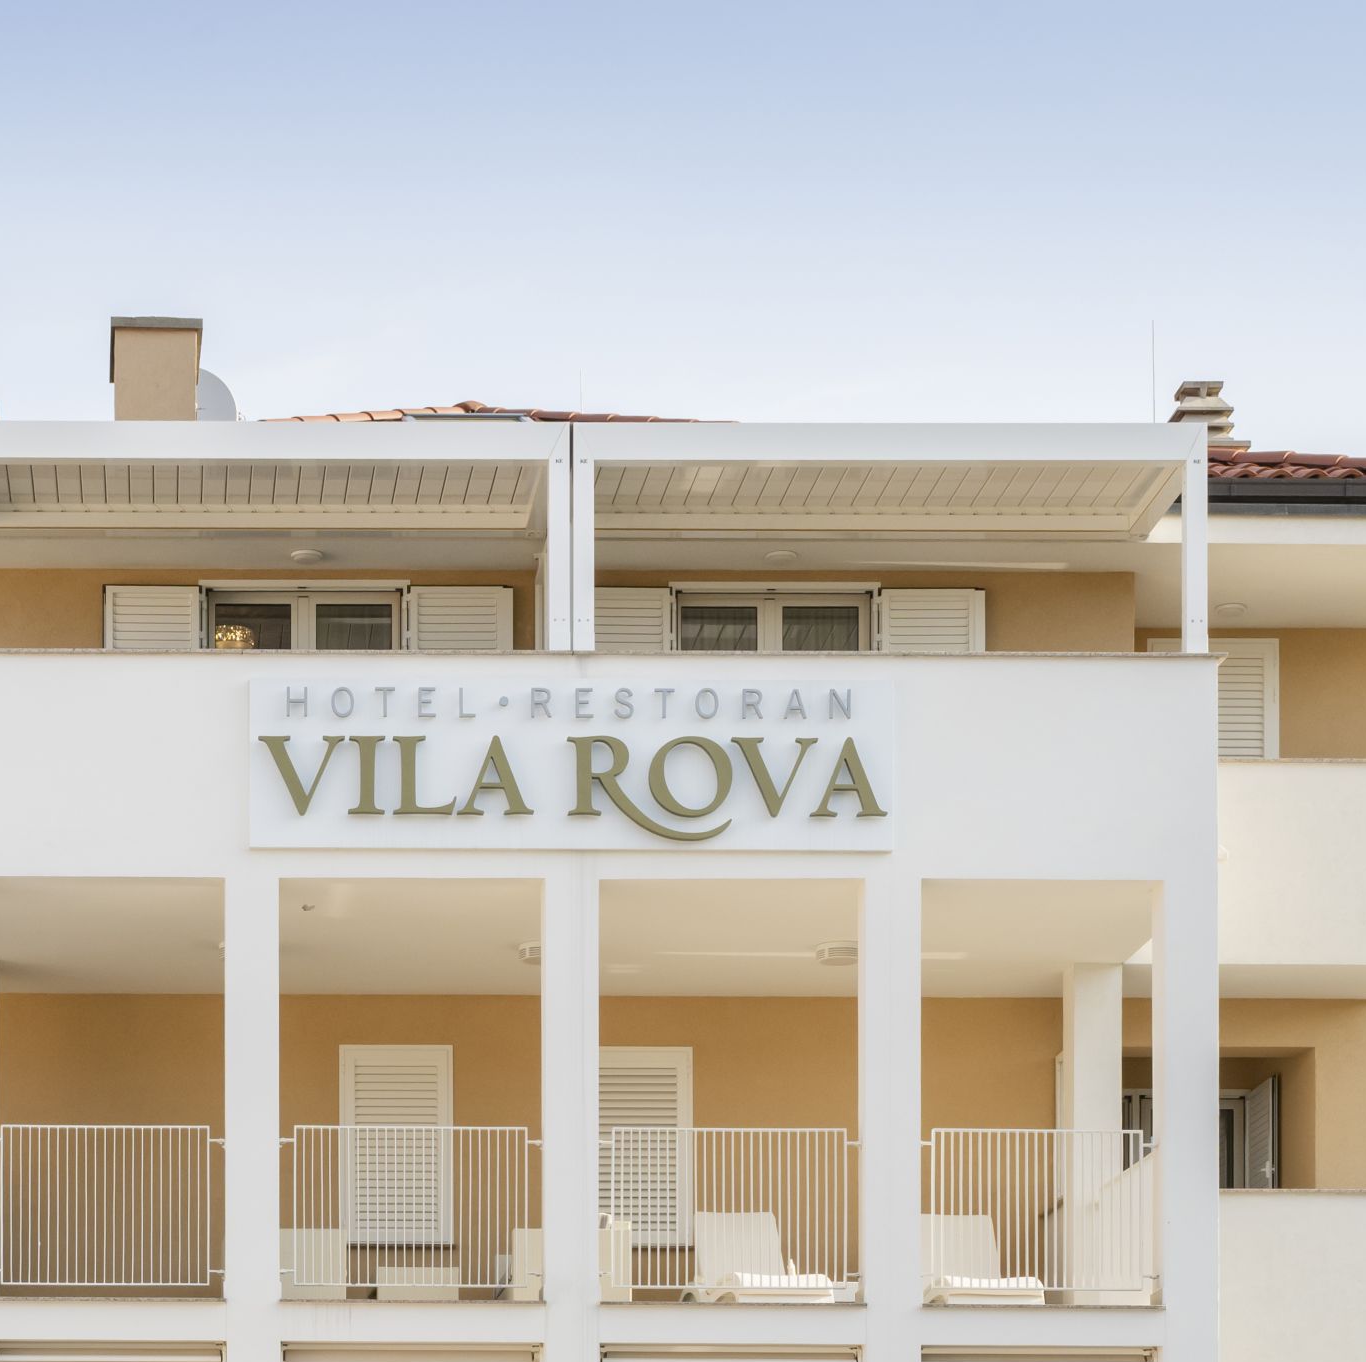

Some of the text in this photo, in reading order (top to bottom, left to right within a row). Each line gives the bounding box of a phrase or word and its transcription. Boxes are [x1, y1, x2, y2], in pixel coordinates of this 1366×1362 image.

[285, 685, 852, 720] HOTEL RESTORAN
[257, 735, 888, 842] VILA ROVA
